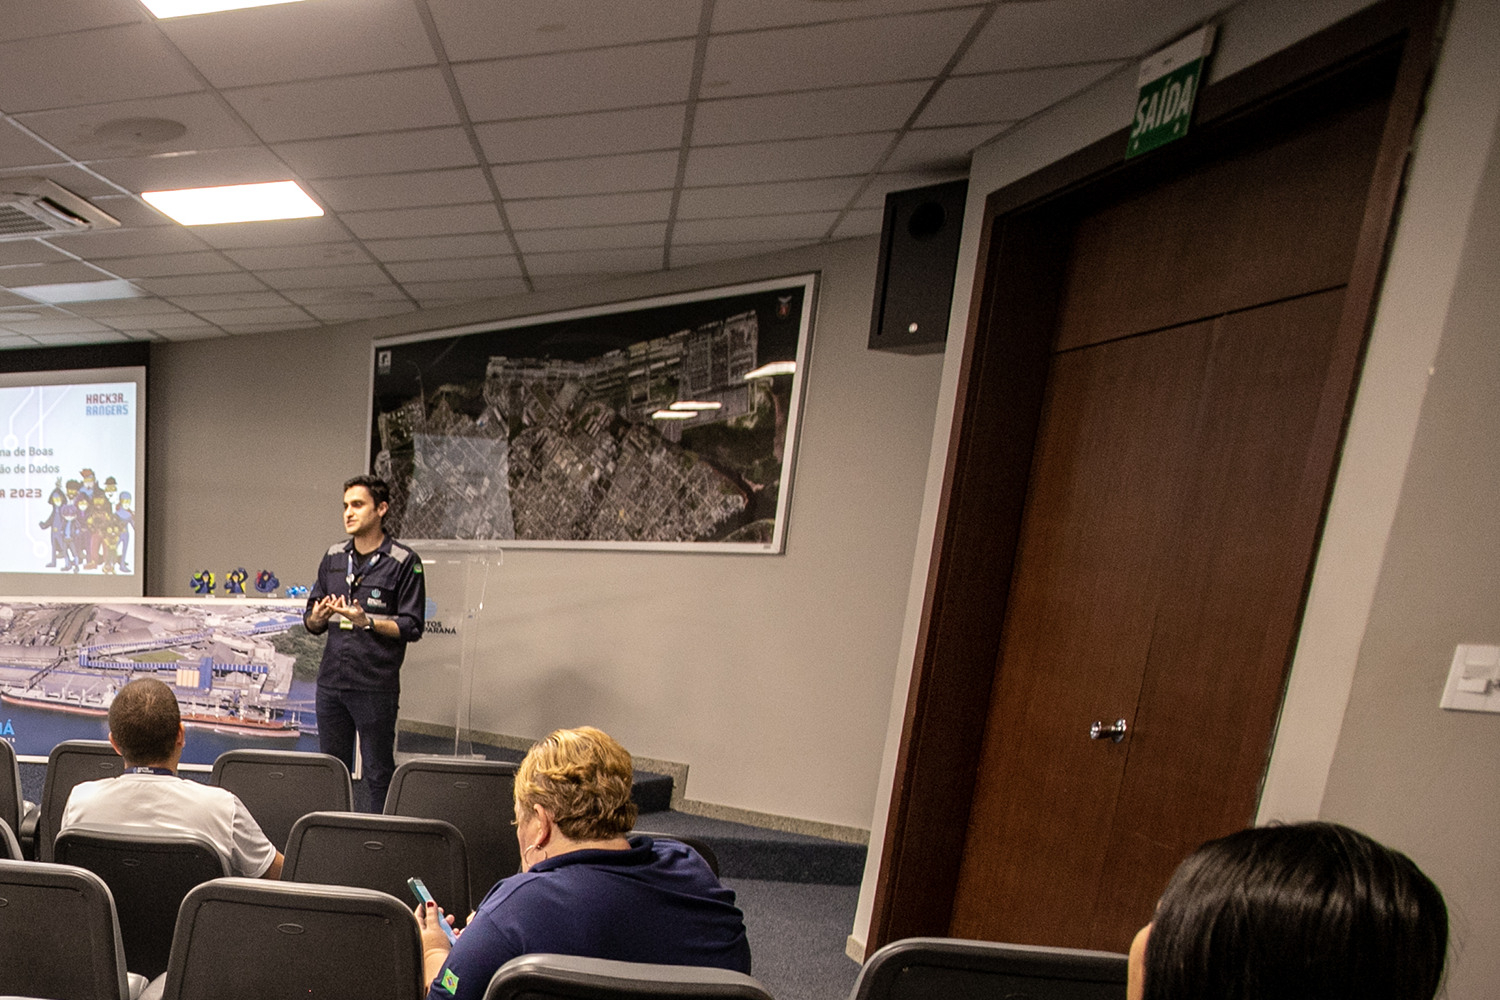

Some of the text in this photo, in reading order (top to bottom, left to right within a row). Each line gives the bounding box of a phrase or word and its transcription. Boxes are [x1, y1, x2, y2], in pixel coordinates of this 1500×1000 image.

[1131, 75, 1193, 138] SAÍDA
[85, 404, 129, 416] RANGERS
[13, 447, 26, 457] de
[28, 447, 54, 457] Boas
[13, 464, 26, 474] de
[28, 463, 60, 474] Dados
[9, 488, 43, 498] 2023
